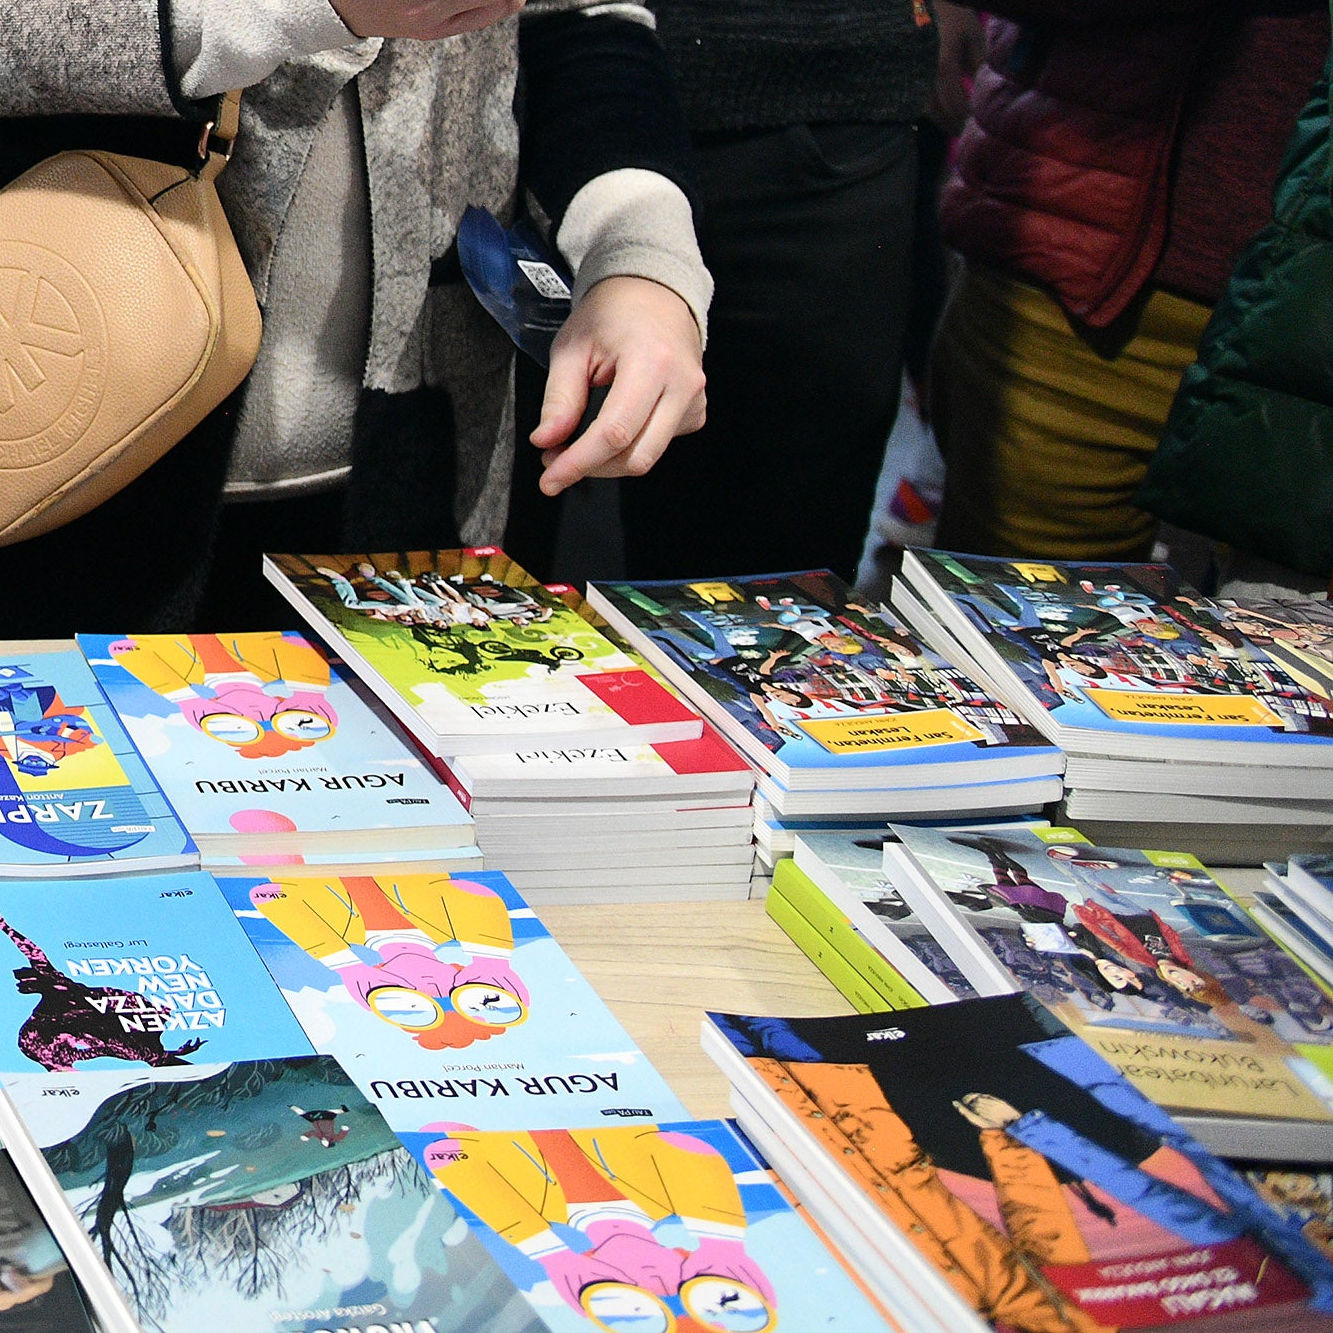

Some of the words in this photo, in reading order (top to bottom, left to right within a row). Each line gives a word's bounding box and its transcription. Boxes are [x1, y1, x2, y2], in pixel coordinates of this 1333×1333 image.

[1220, 712, 1249, 723] San
[921, 732, 953, 743] San
[195, 777, 310, 795] KARIBU
[318, 772, 405, 793] AGUR
[26, 793, 64, 802] Antton
[159, 888, 194, 900] elkar
[253, 890, 288, 901] elkar
[63, 938, 125, 951] Gallastegi
[128, 939, 148, 949] Lur
[66, 953, 202, 977] YORKEN
[137, 971, 213, 994] NEW
[82, 990, 222, 1014] DANTZA
[118, 1008, 227, 1033] AZKEN
[865, 1031, 905, 1042] elkar
[443, 1063, 482, 1073] Porcel
[487, 1062, 524, 1072] Marian
[370, 1078, 509, 1100] KARIBU
[521, 1070, 620, 1099] AGUR
[41, 1086, 80, 1099] elkar
[429, 1150, 470, 1163] elkar
